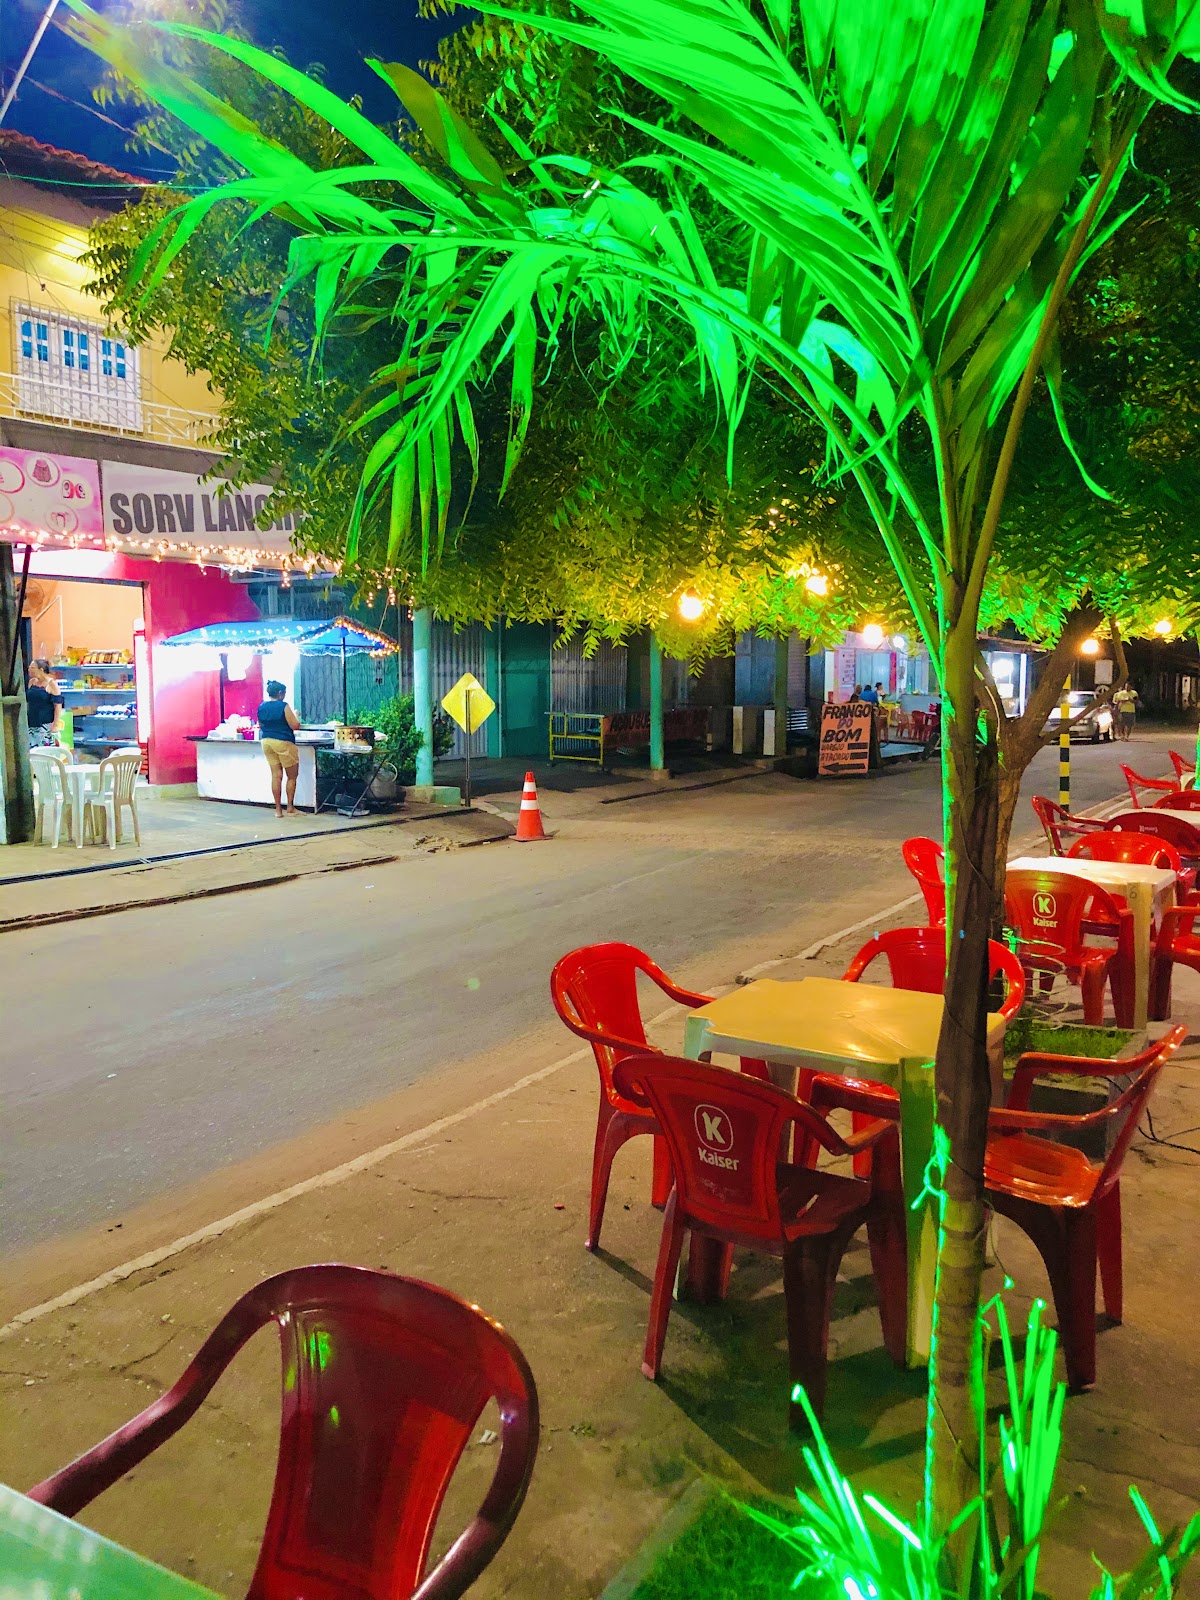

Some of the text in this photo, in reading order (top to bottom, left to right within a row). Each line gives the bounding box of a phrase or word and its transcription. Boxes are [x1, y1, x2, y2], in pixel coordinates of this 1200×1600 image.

[110, 493, 194, 533] SORV
[823, 704, 871, 719] FRANGO
[838, 718, 853, 729] DO
[823, 728, 862, 742] BOM
[1038, 896, 1051, 914] K
[1033, 917, 1058, 928] Kaiser
[702, 1111, 726, 1144] K
[698, 1147, 739, 1170] Kaiser
